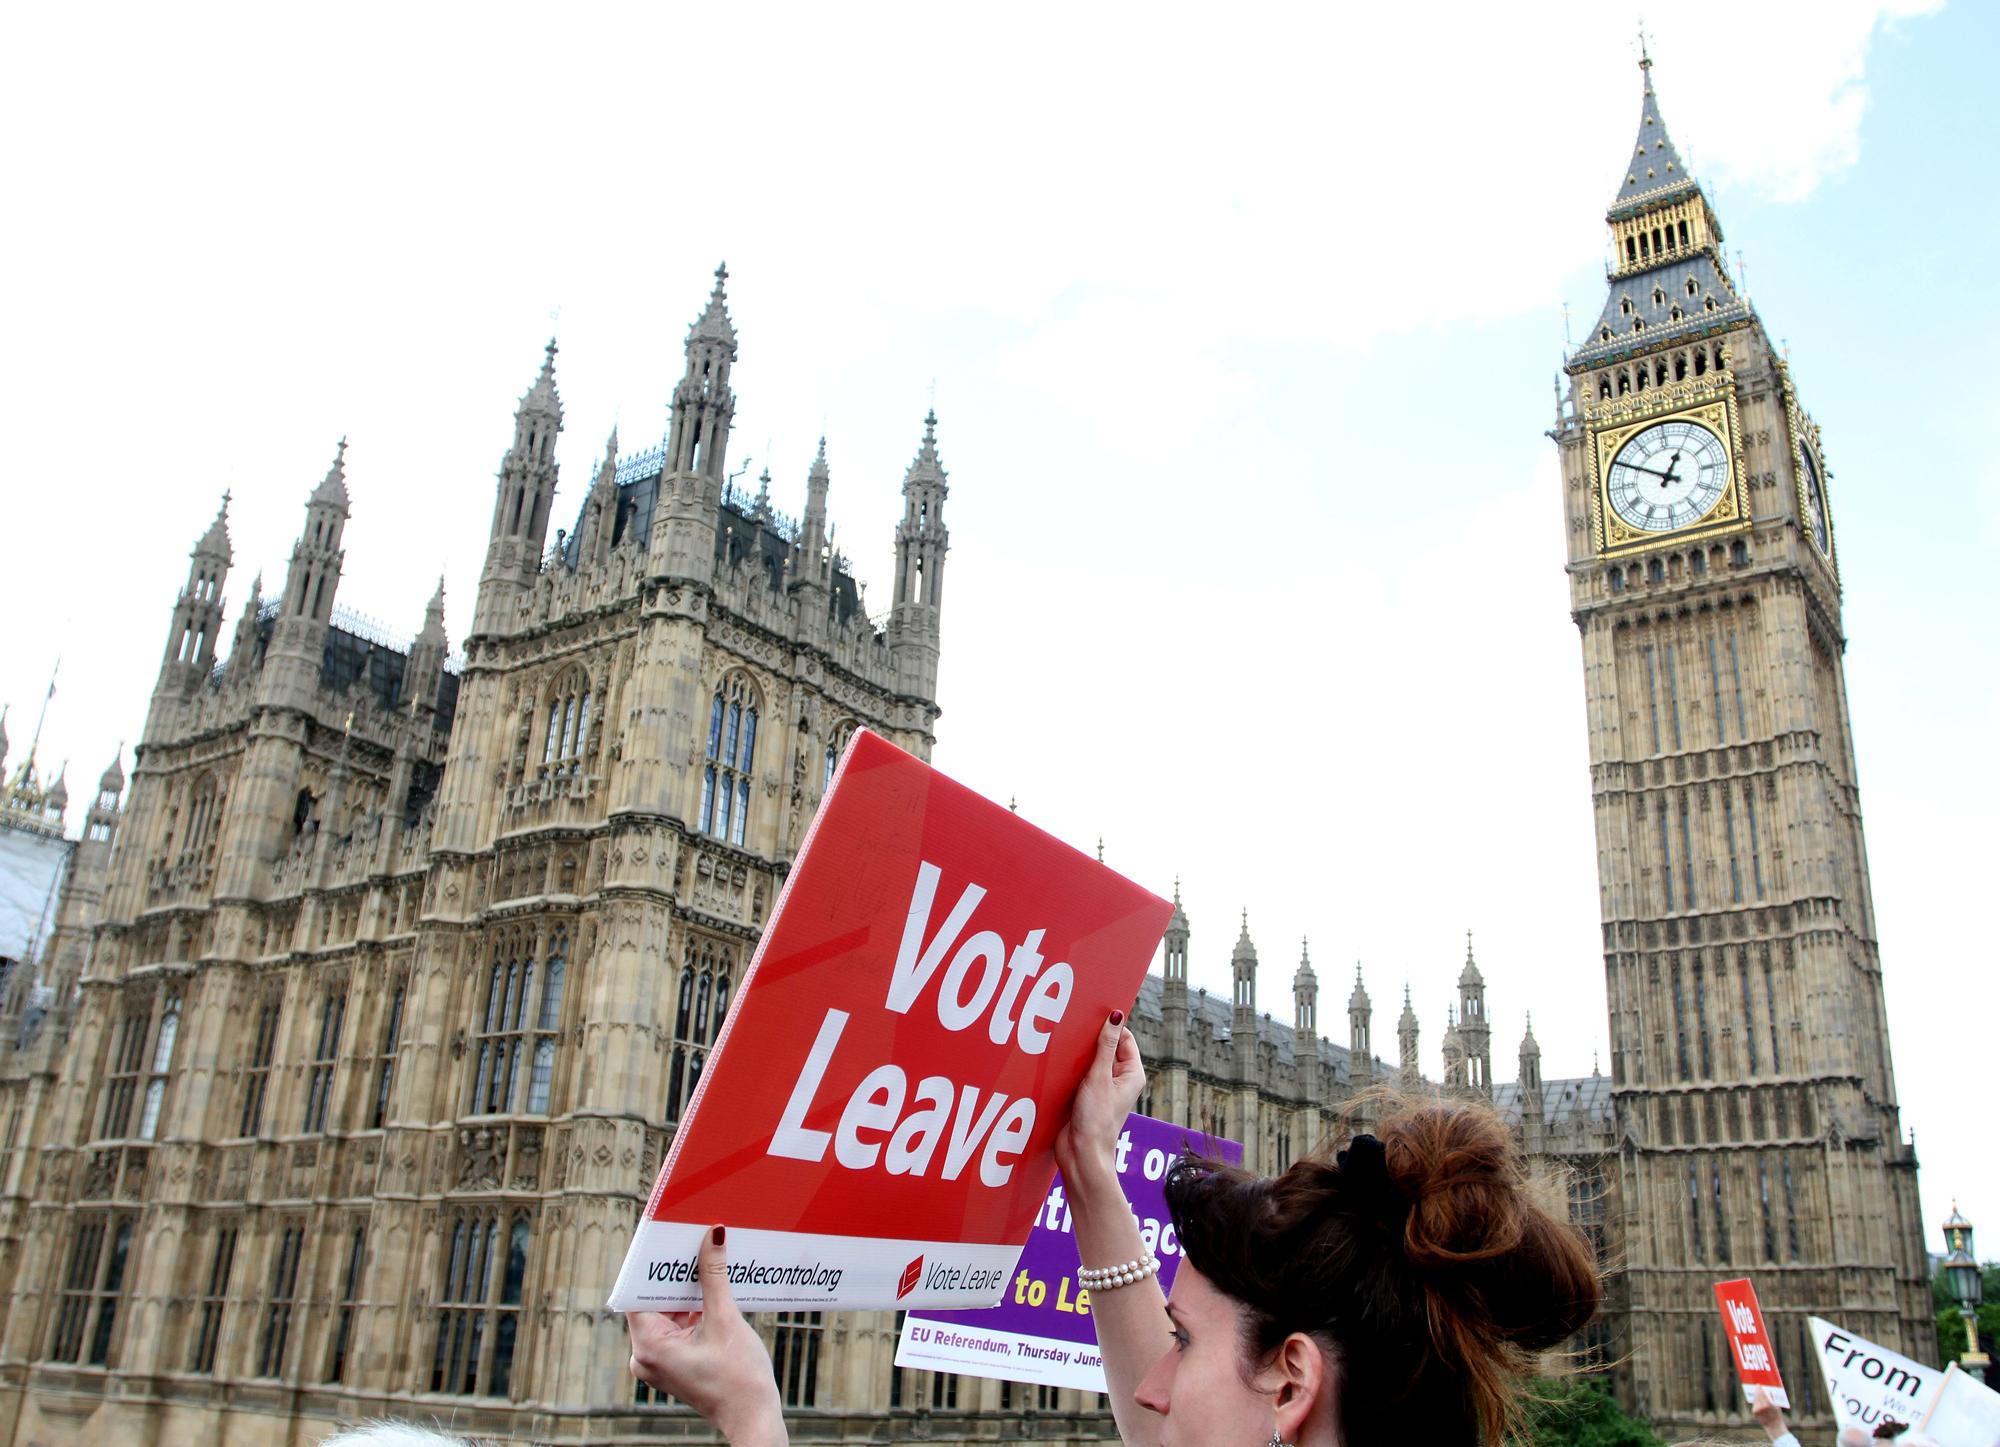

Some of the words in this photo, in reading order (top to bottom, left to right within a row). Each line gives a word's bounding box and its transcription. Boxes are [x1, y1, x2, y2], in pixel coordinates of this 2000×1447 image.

[885, 860, 1074, 1055] Vote
[766, 1007, 1037, 1188] Leave
[648, 1256, 843, 1292] voteletakecontrol.org
[925, 1262, 961, 1290] Vote
[960, 1263, 1003, 1290] Leave
[1014, 1269, 1046, 1306] to
[1726, 1299, 1757, 1334] Vote
[911, 1327, 931, 1342] EU
[934, 1330, 1012, 1355] Referendum,
[1017, 1342, 1071, 1365] Thursday
[1073, 1352, 1102, 1367] June
[1734, 1336, 1771, 1371] Leave
[1825, 1332, 1922, 1397] From
